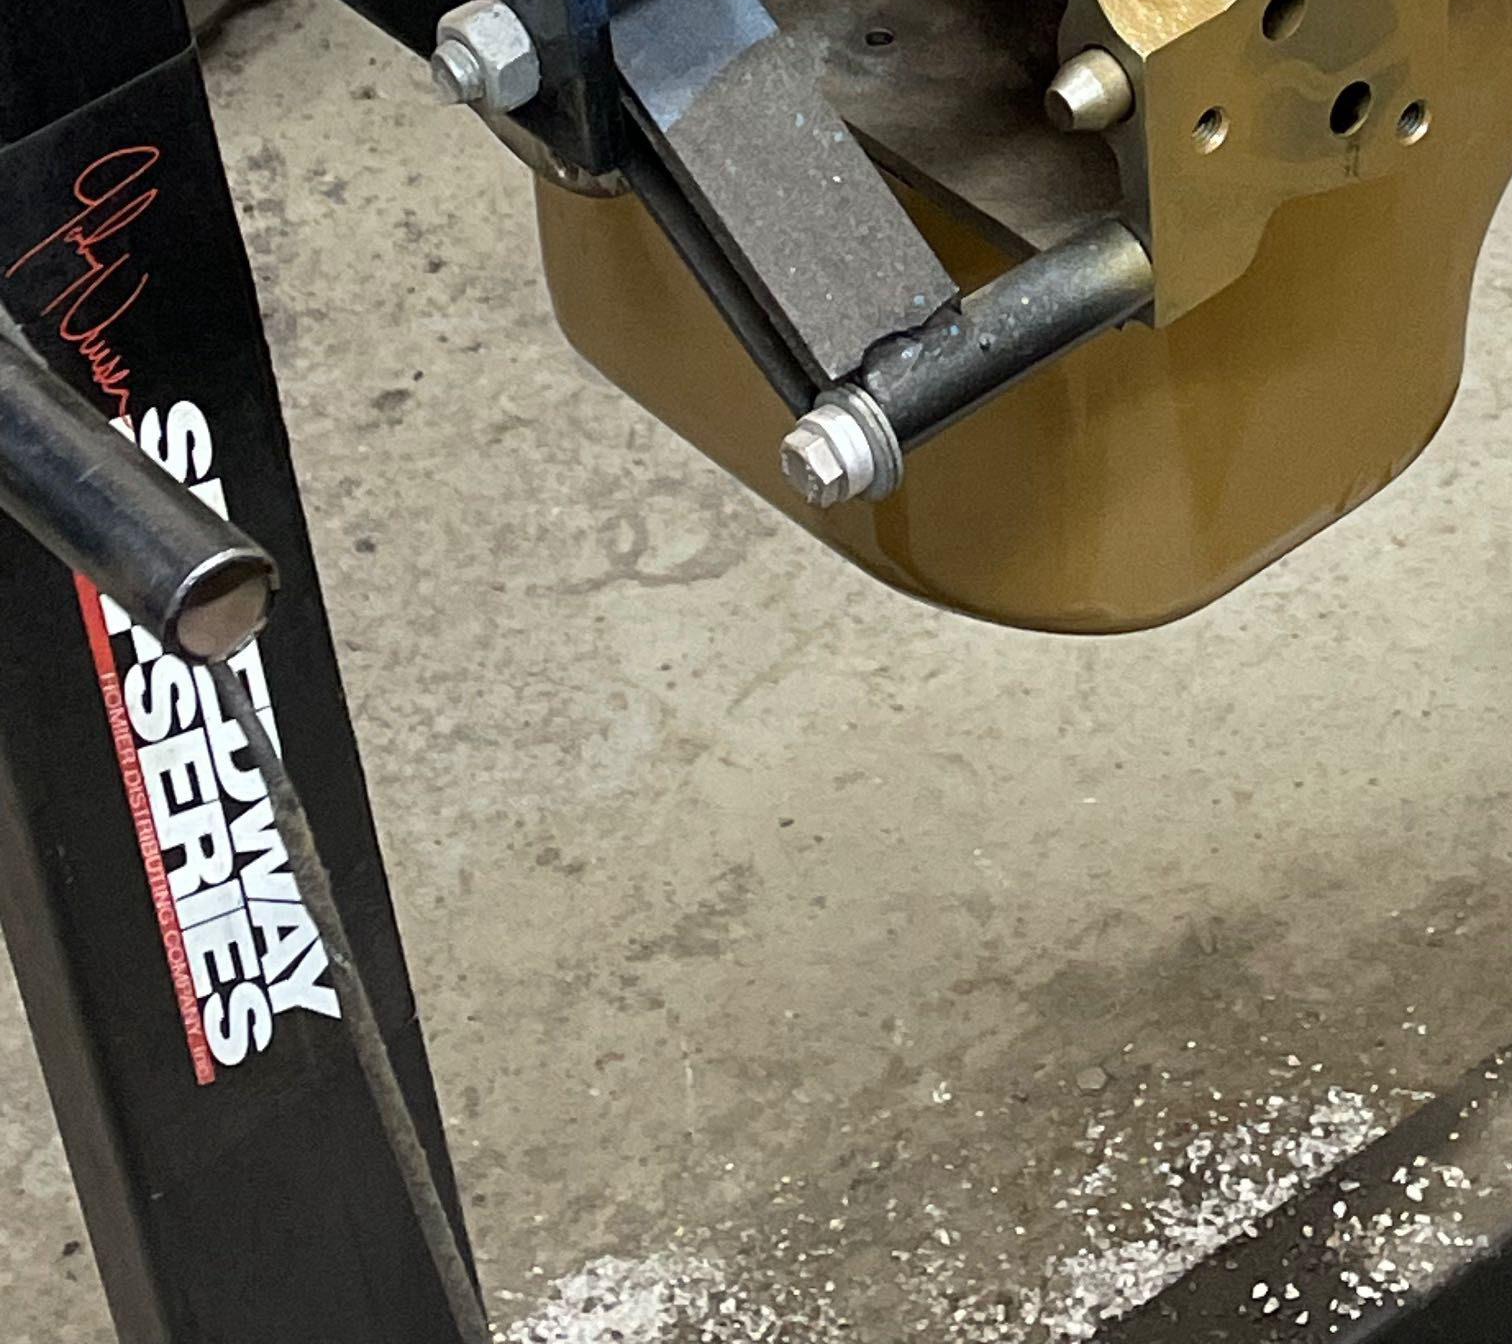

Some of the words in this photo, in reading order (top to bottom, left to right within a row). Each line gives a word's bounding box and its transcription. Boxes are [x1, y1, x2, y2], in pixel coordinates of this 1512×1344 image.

[99, 671, 137, 765] HOMIER
[122, 766, 176, 926] DISTRIBUTING
[135, 399, 342, 1020] SEDWAY
